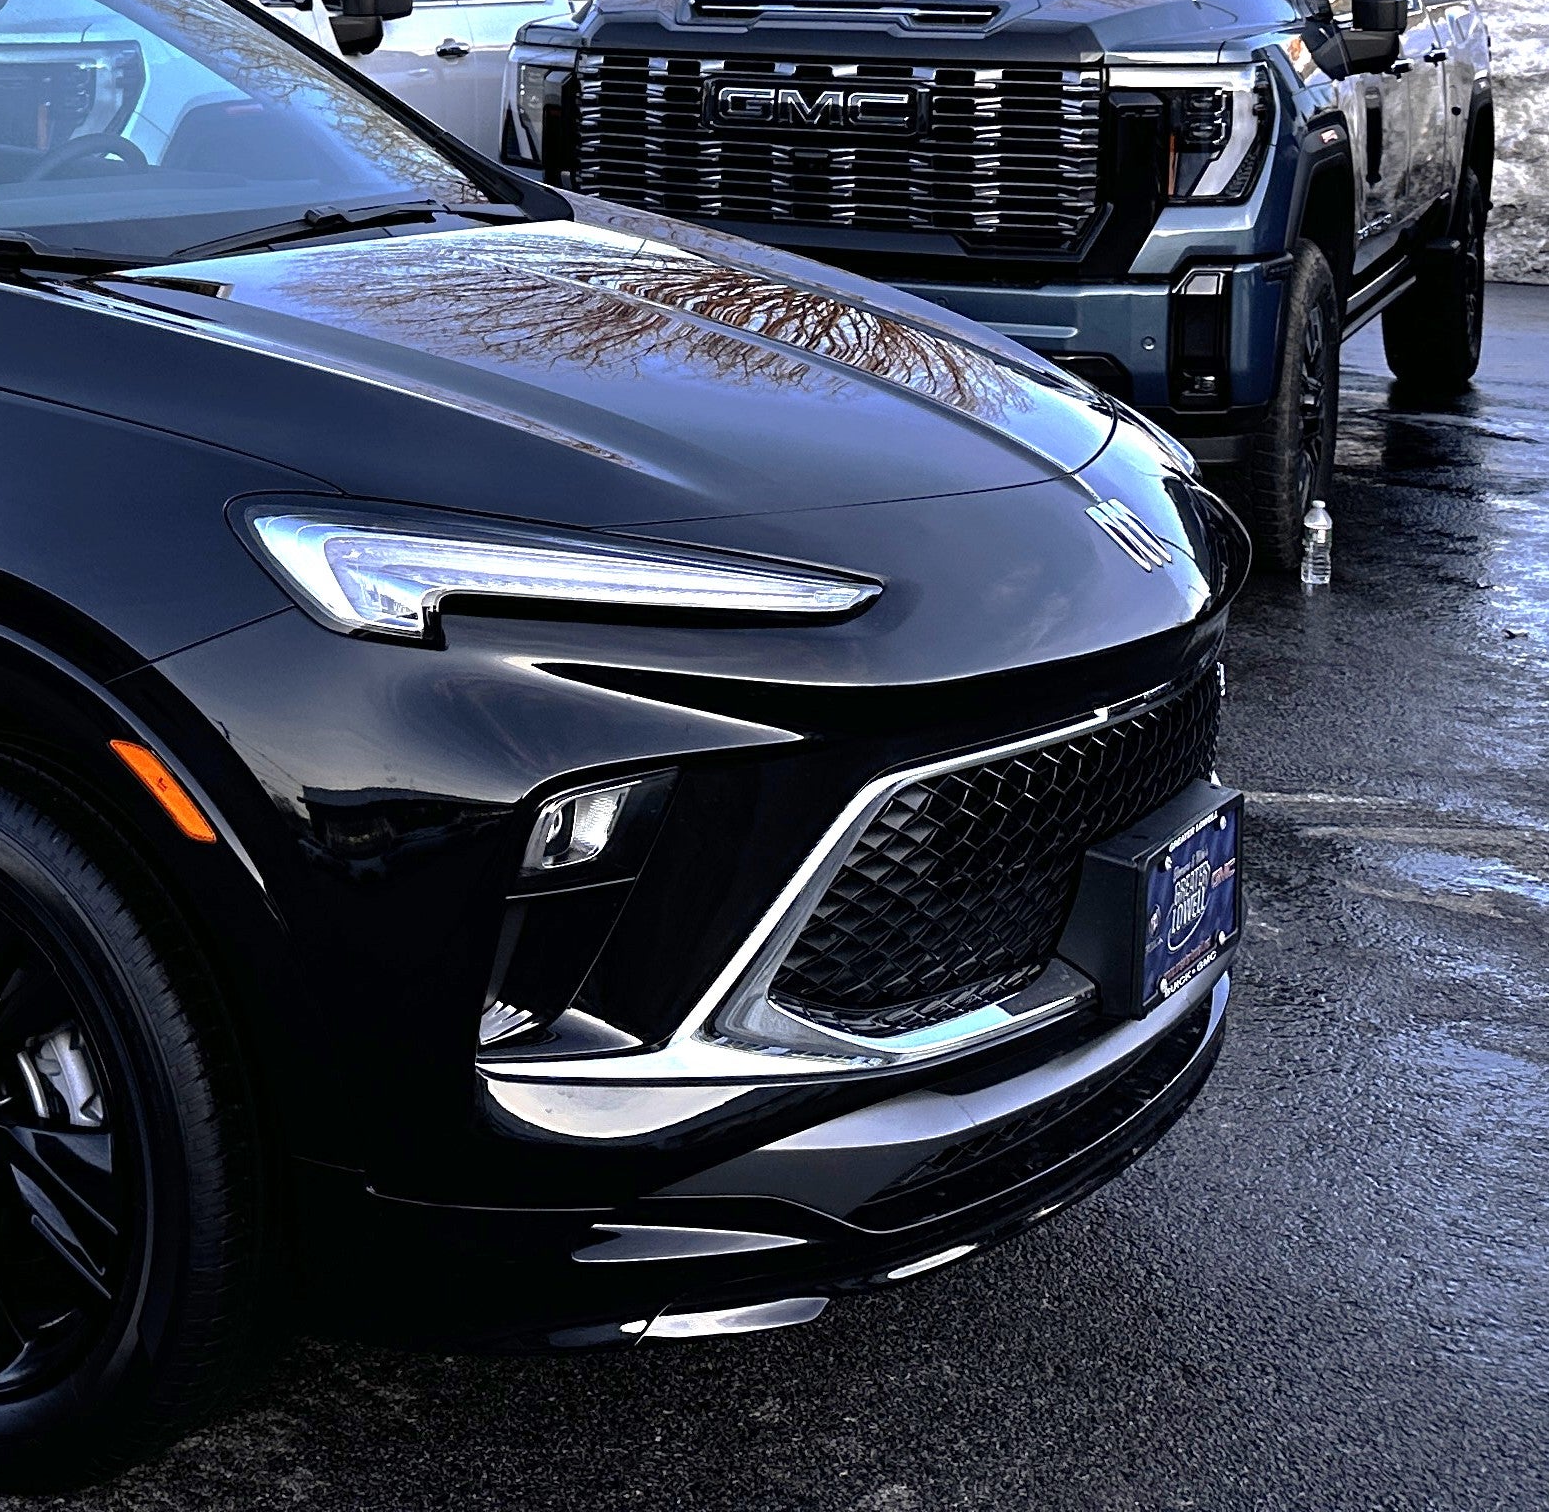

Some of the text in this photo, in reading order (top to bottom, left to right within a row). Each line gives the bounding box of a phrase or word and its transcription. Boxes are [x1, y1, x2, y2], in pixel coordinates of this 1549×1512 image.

[718, 86, 910, 127] GMC
[1174, 860, 1211, 906] GREATER
[1211, 857, 1236, 889] GMC
[1171, 886, 1207, 934] LOWELL
[1164, 970, 1192, 998] BUICK
[1196, 950, 1217, 972] GMC
